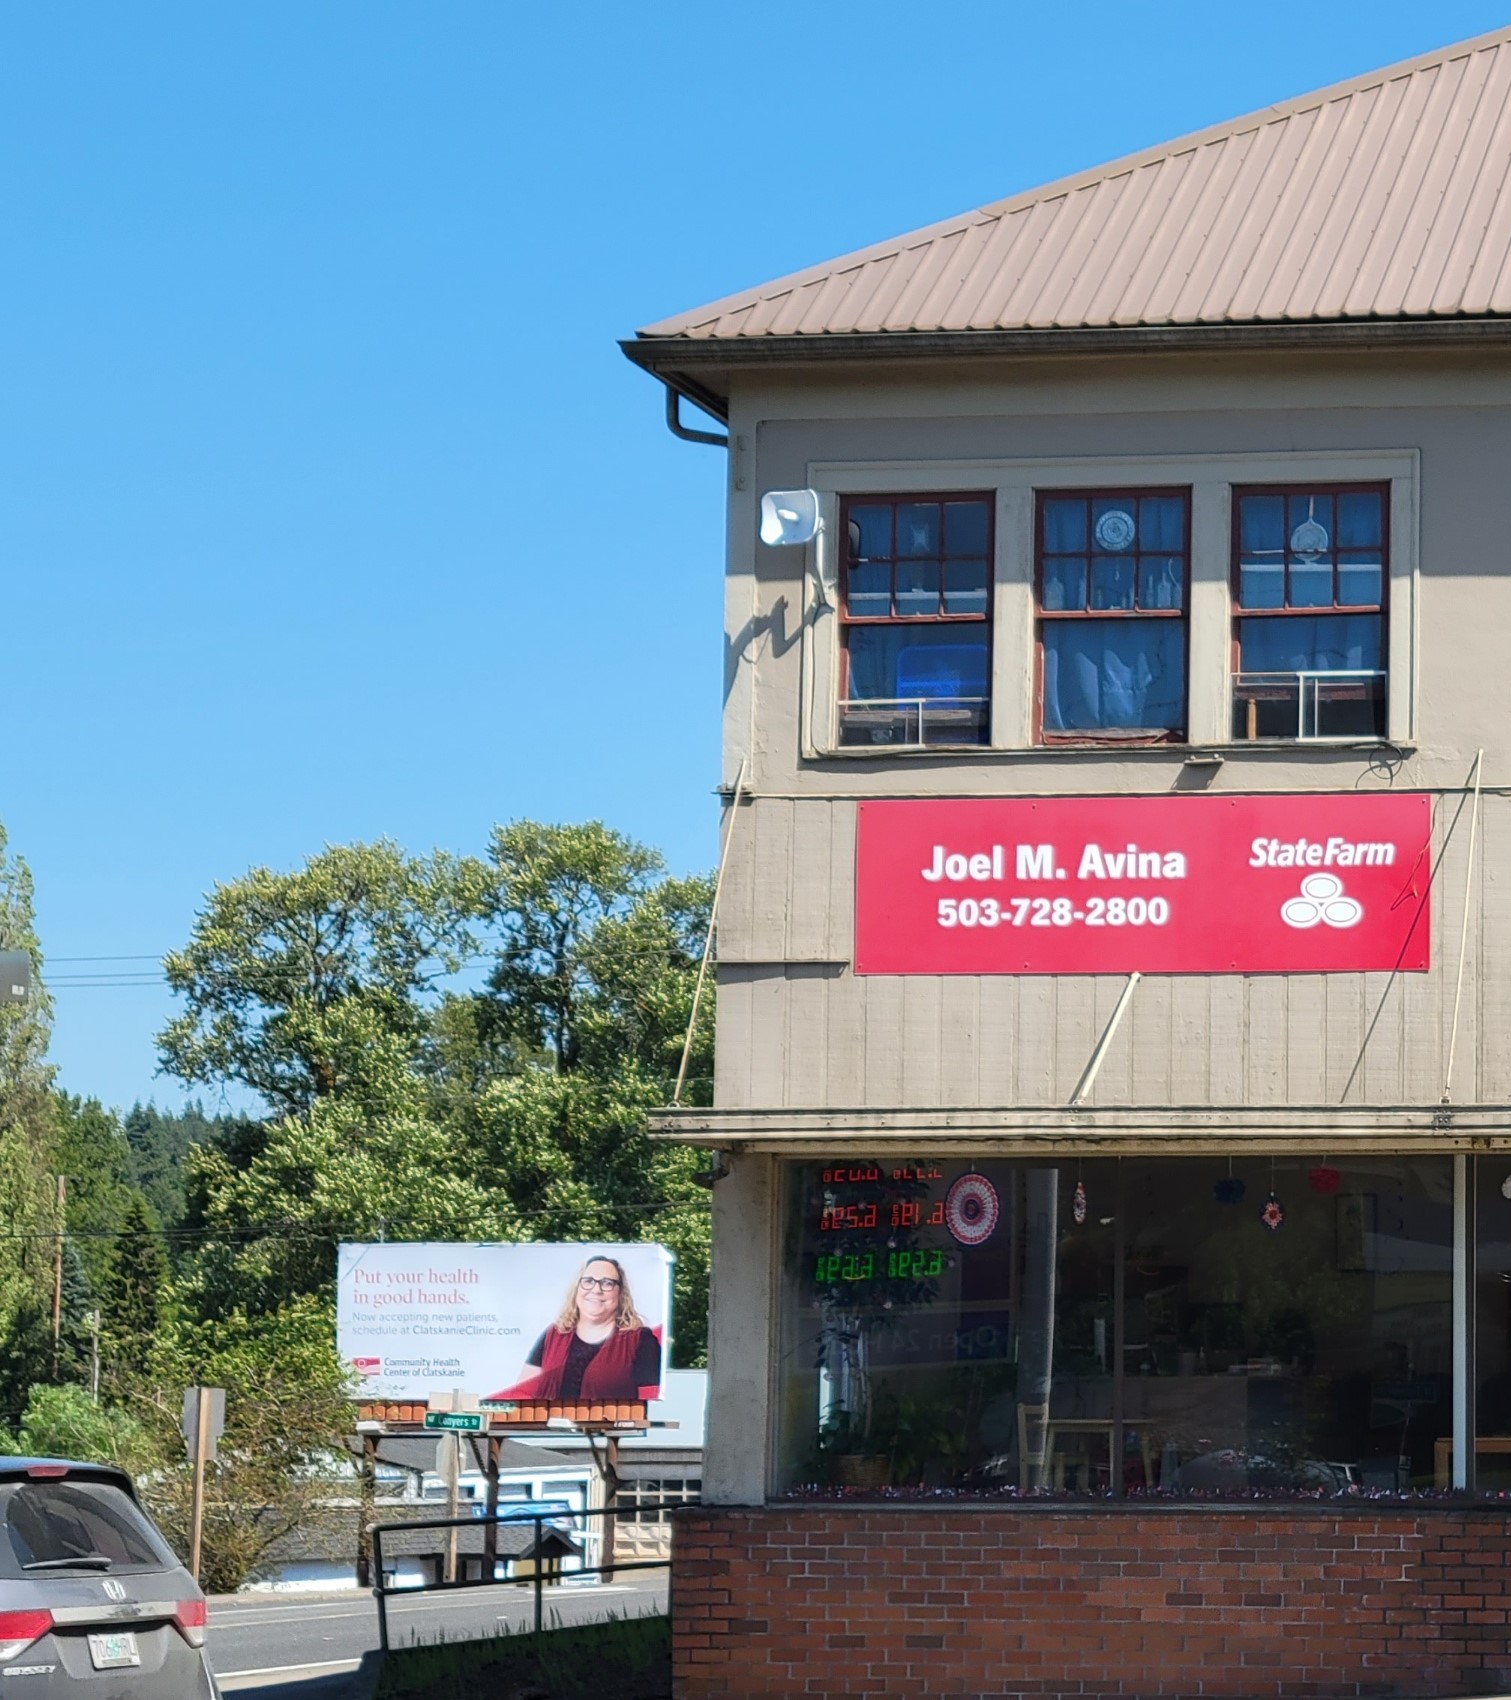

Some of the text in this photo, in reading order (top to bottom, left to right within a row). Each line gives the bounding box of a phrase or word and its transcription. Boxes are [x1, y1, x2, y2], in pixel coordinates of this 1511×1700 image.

[1249, 837, 1396, 868] StateFarm
[921, 844, 1186, 882] Joel M. Avina
[937, 897, 1169, 927] 503-728-2800
[354, 1268, 480, 1287] Put your health
[353, 1288, 470, 1308] in good hands.
[352, 1312, 498, 1324] Now accepting new patients,
[352, 1325, 521, 1336] schedule at ClatskanieClinic.com
[384, 1358, 460, 1367] Community Health
[384, 1368, 465, 1377] Center of Clatskanie
